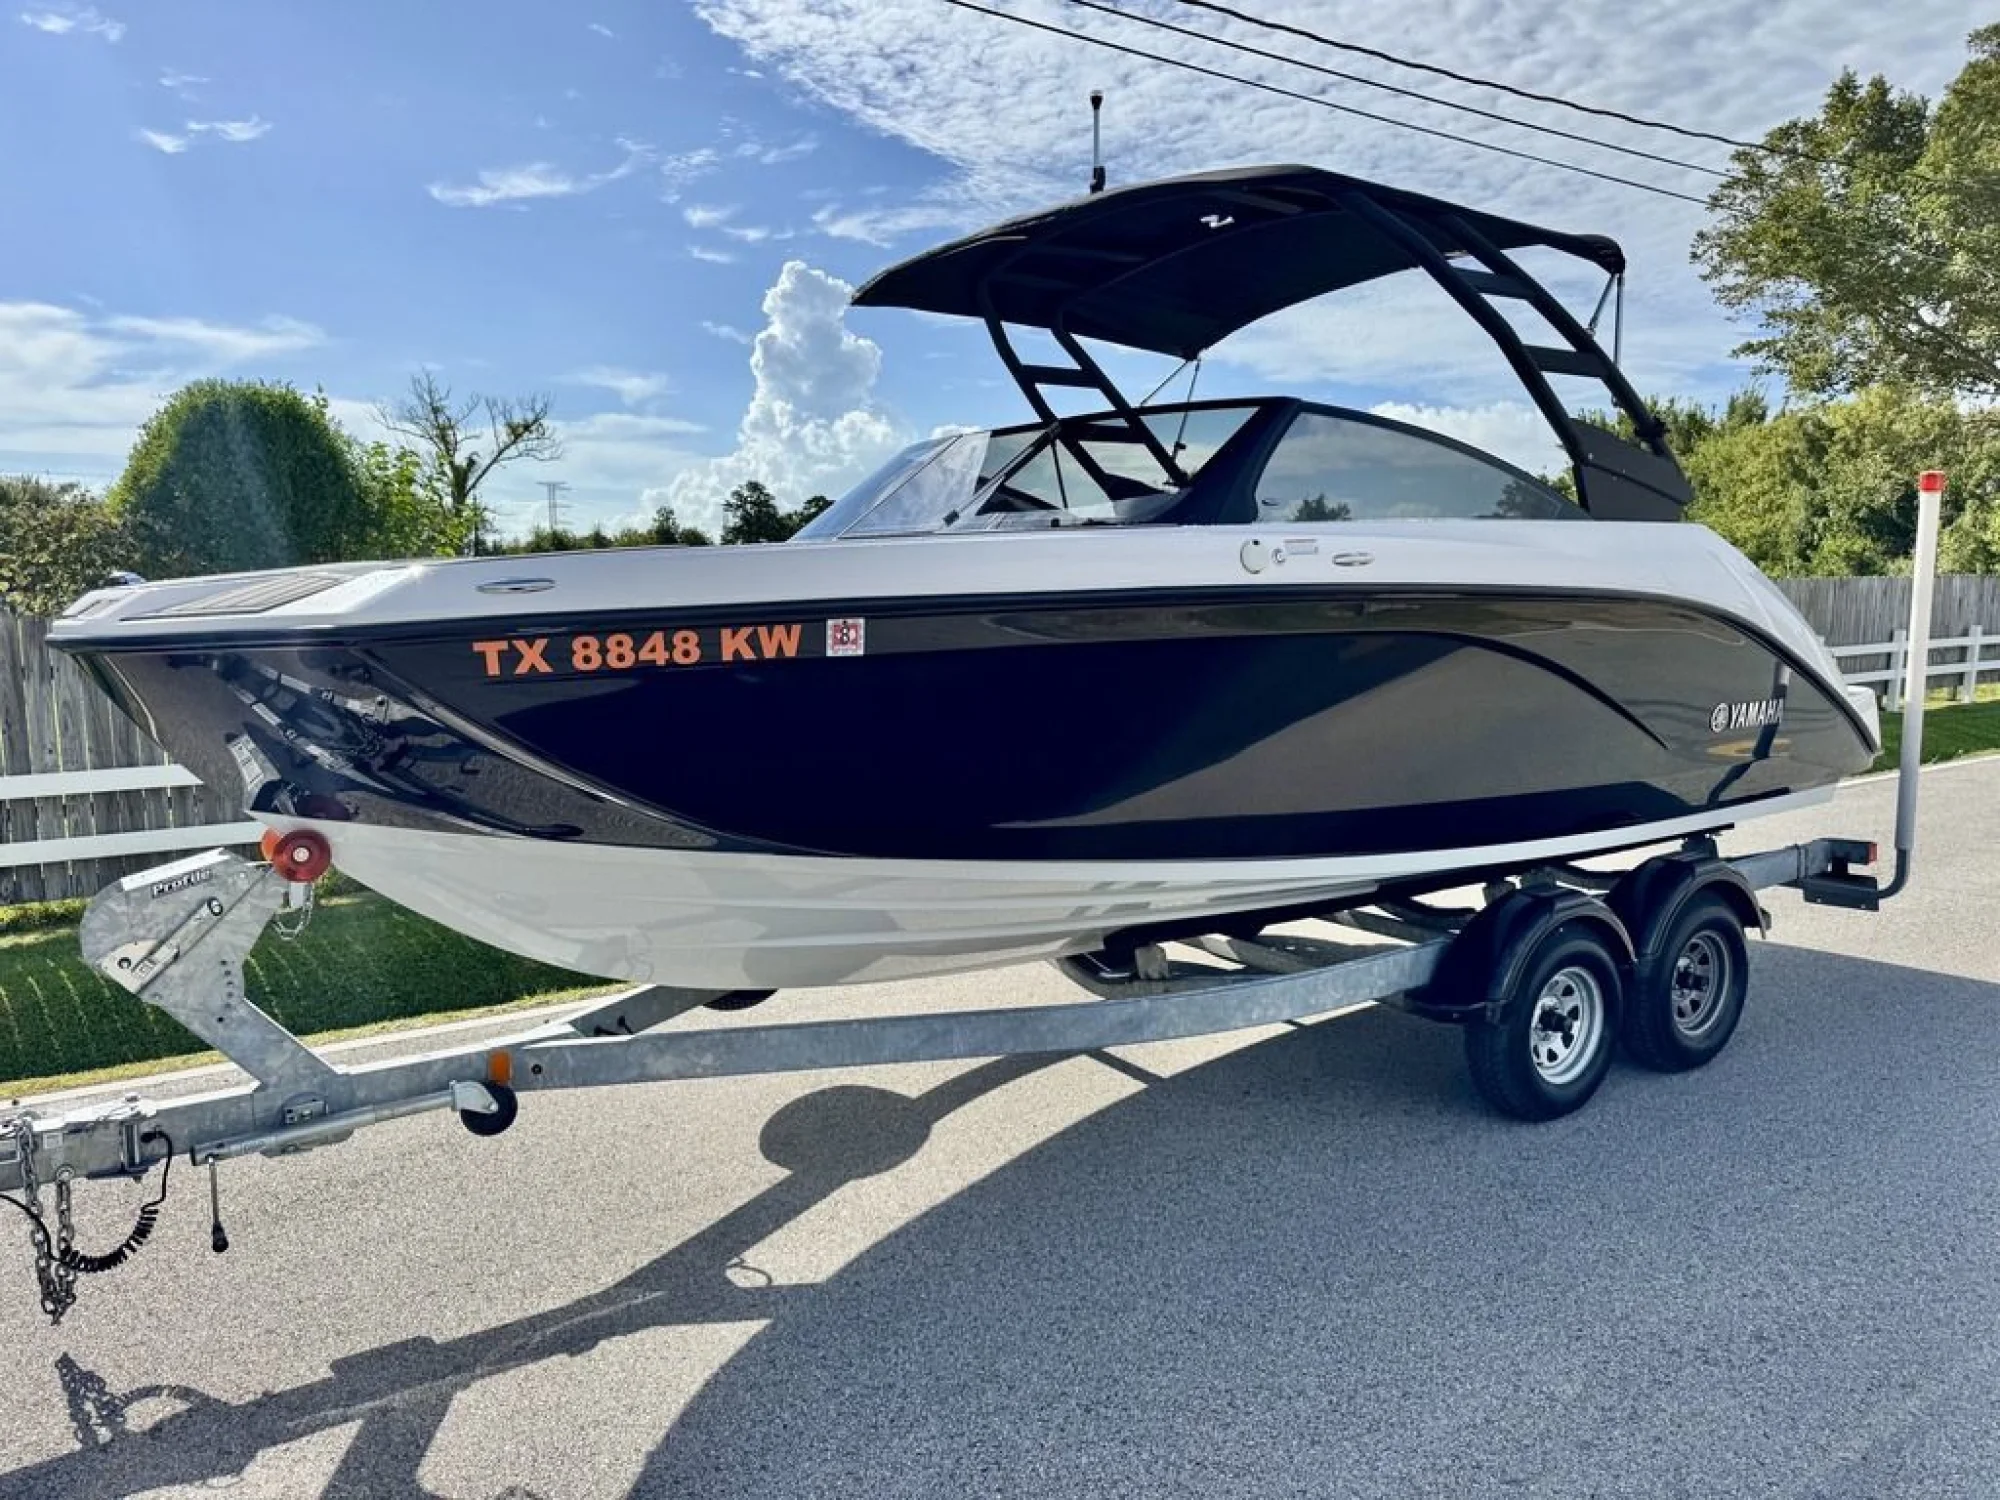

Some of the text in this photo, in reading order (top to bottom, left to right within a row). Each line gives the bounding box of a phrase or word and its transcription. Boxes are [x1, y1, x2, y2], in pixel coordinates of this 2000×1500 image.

[473, 625, 801, 677] TX 8848 KW
[1729, 699, 1784, 729] YAMAHA
